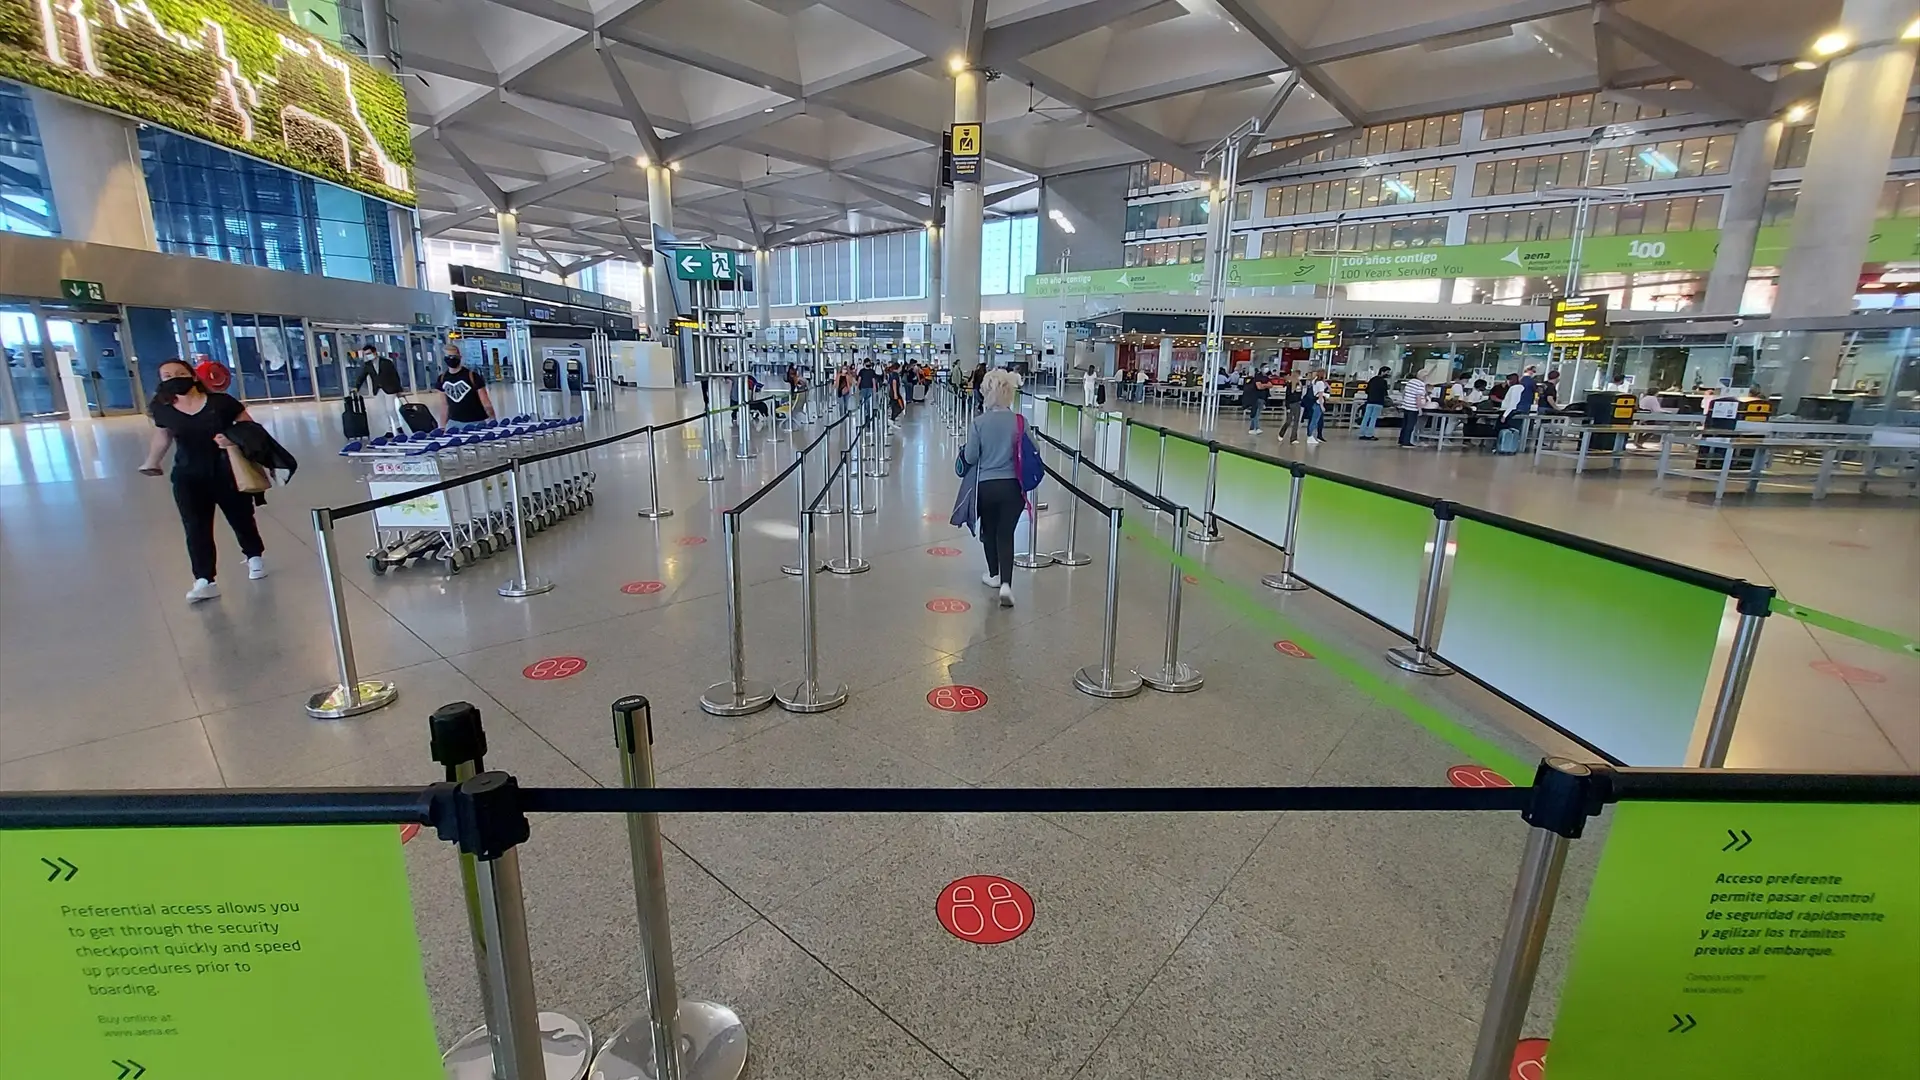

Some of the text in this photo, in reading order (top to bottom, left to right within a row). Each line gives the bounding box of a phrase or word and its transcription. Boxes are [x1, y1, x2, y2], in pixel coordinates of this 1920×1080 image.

[1628, 240, 1665, 258] 100
[1342, 252, 1438, 267] 100 años contigo
[1524, 252, 1551, 260] aena
[1340, 264, 1464, 280] 100 Years Serving You
[1715, 873, 1843, 886] Acceso preferente
[1710, 892, 1876, 904] permite pasar el control
[61, 902, 300, 917] Preferential access allows you
[1705, 910, 1723, 920] de
[1726, 910, 1794, 922] seguridad
[68, 921, 279, 940] to get through the security
[1698, 929, 1710, 940] y
[1712, 927, 1762, 940] agilizar
[1765, 928, 1785, 938] los
[76, 940, 301, 959] checkpoint quickly and speed
[1694, 945, 1746, 957] previos
[1748, 945, 1761, 955] al
[82, 961, 251, 979] up procedures prior to
[88, 984, 160, 997] boarding.
[97, 1014, 171, 1025] Buy online at
